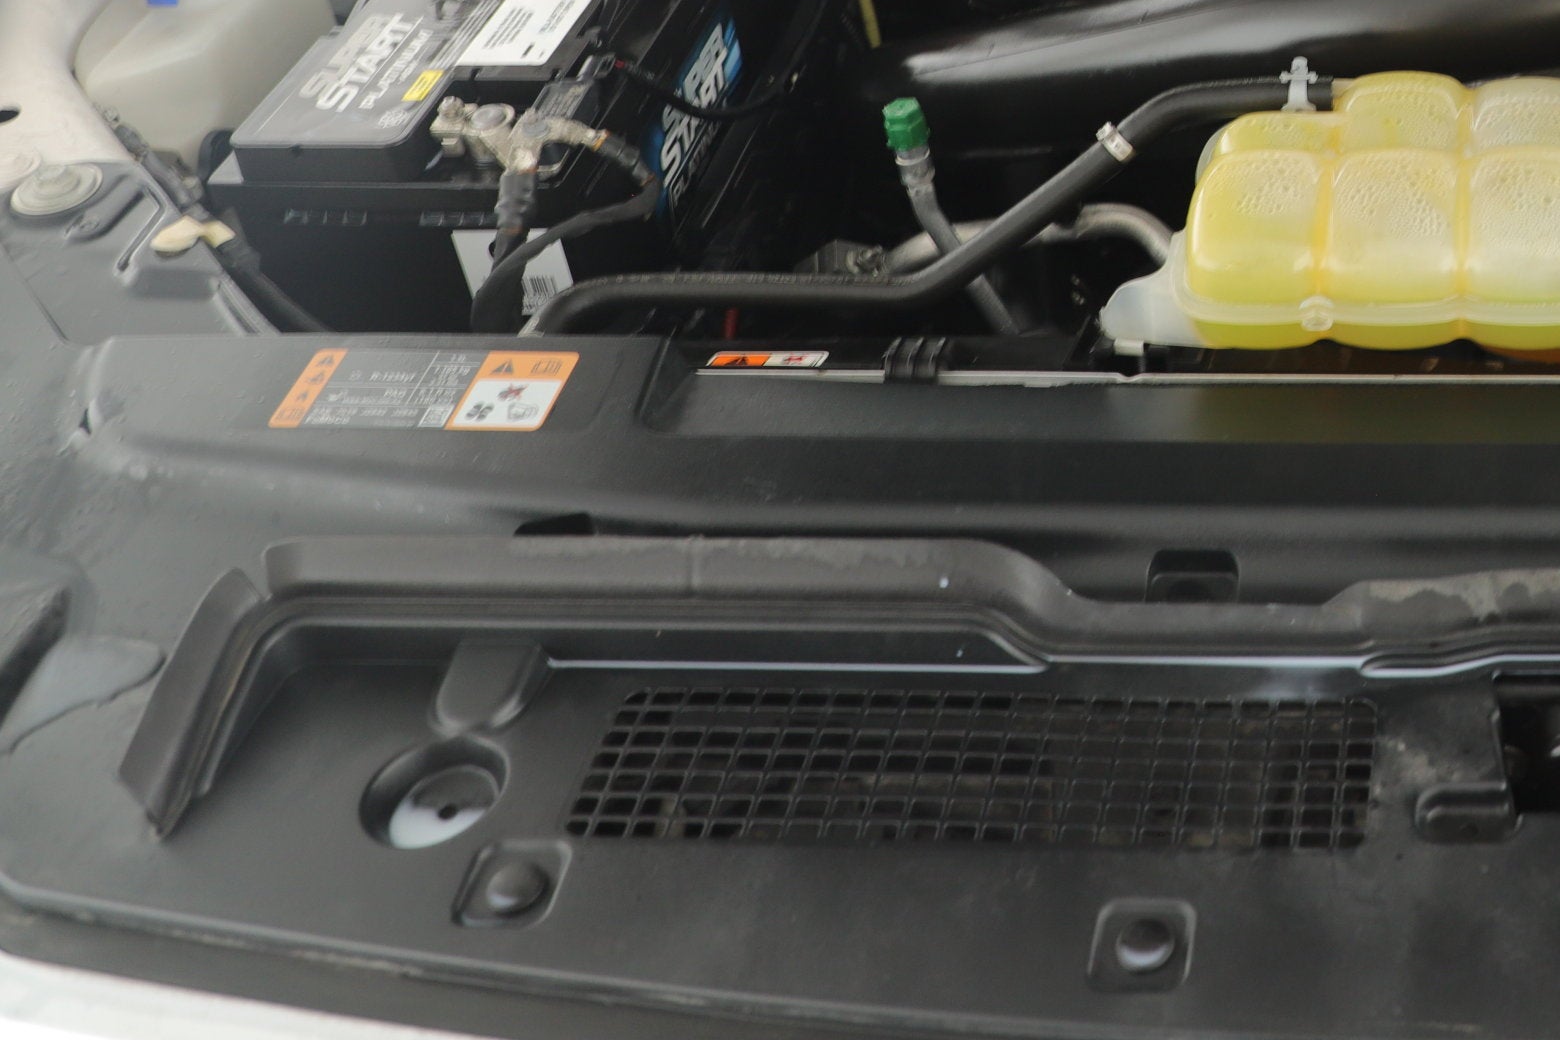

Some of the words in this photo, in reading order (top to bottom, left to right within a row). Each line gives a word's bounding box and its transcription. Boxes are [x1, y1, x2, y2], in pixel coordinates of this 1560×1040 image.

[299, 15, 392, 98] SUPER
[316, 13, 413, 112] START
[358, 30, 434, 109] PLATINUM
[661, 22, 724, 133] SPER
